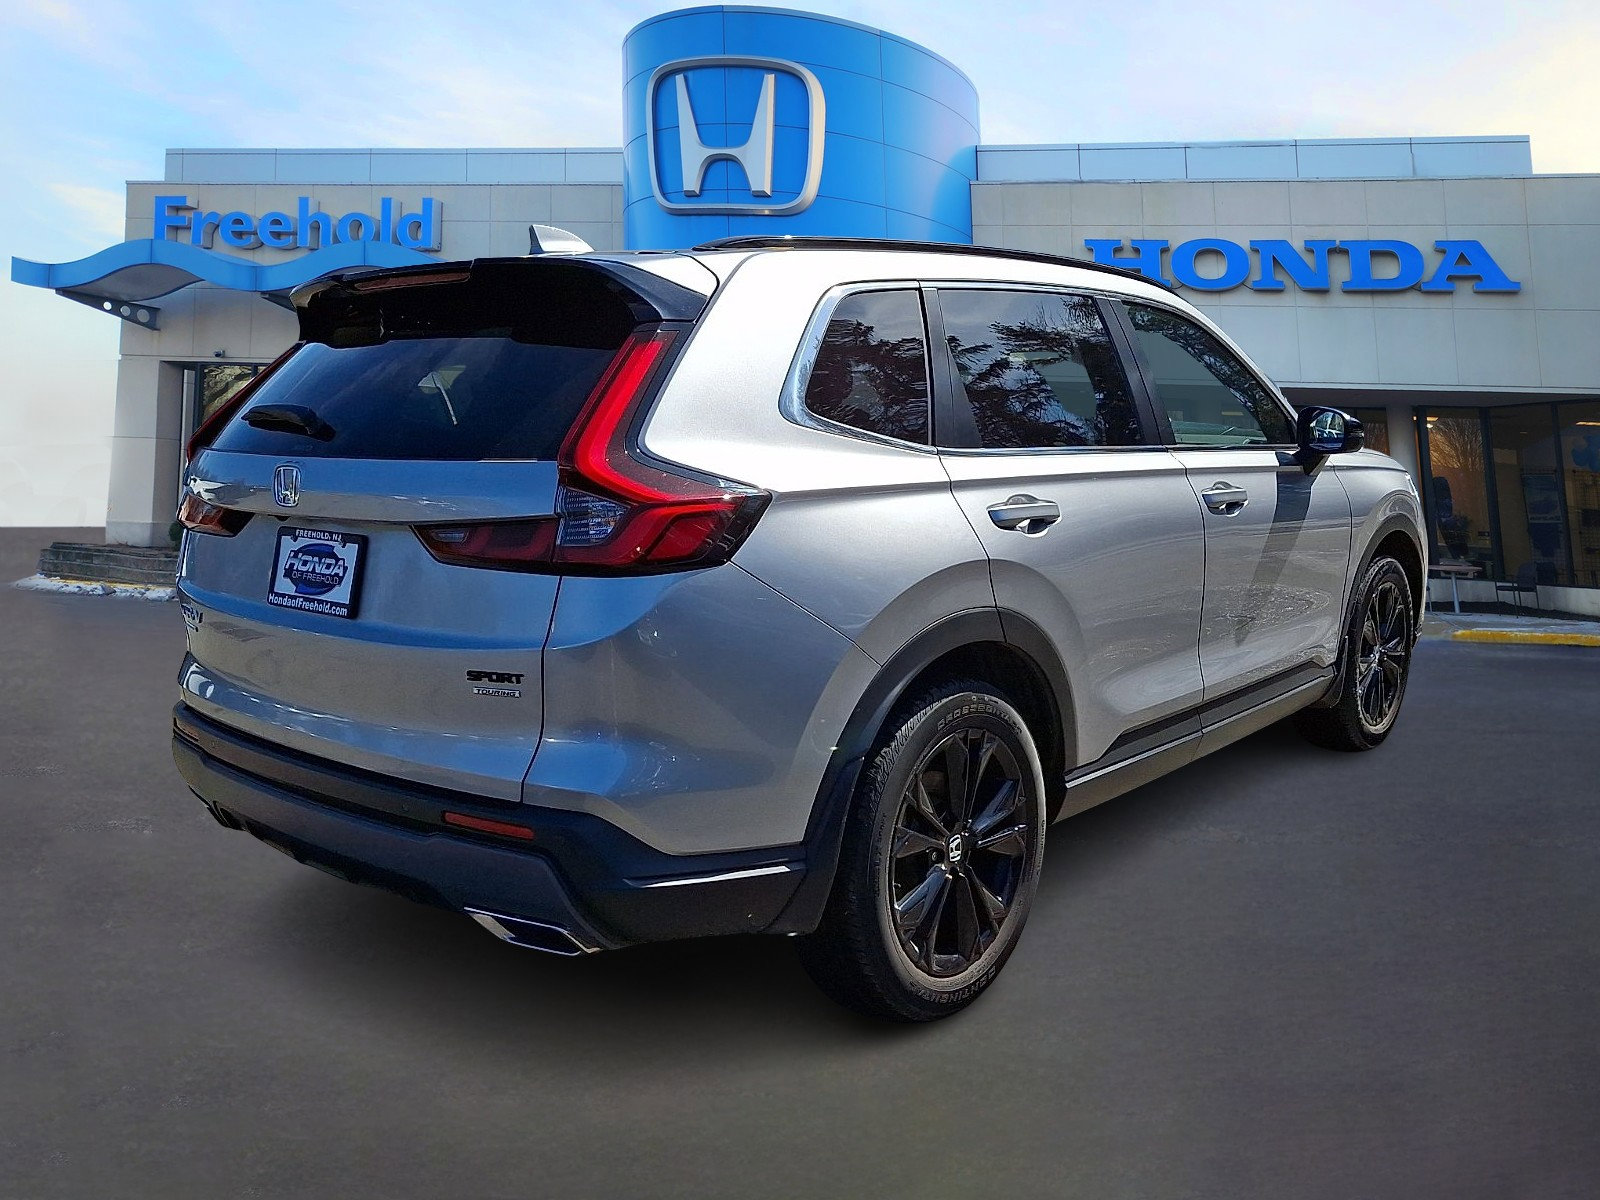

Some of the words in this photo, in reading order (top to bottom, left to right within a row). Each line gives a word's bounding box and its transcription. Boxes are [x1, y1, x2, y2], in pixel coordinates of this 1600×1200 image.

[154, 196, 437, 250] Freehold
[1083, 238, 1521, 292] HONDA
[285, 552, 344, 577] HONDA
[292, 570, 302, 579] OF
[302, 573, 339, 585] FREEHOLD
[268, 593, 348, 617] HondaofFreehold.com
[466, 669, 525, 684] SPORT
[473, 687, 521, 698] TOURING
